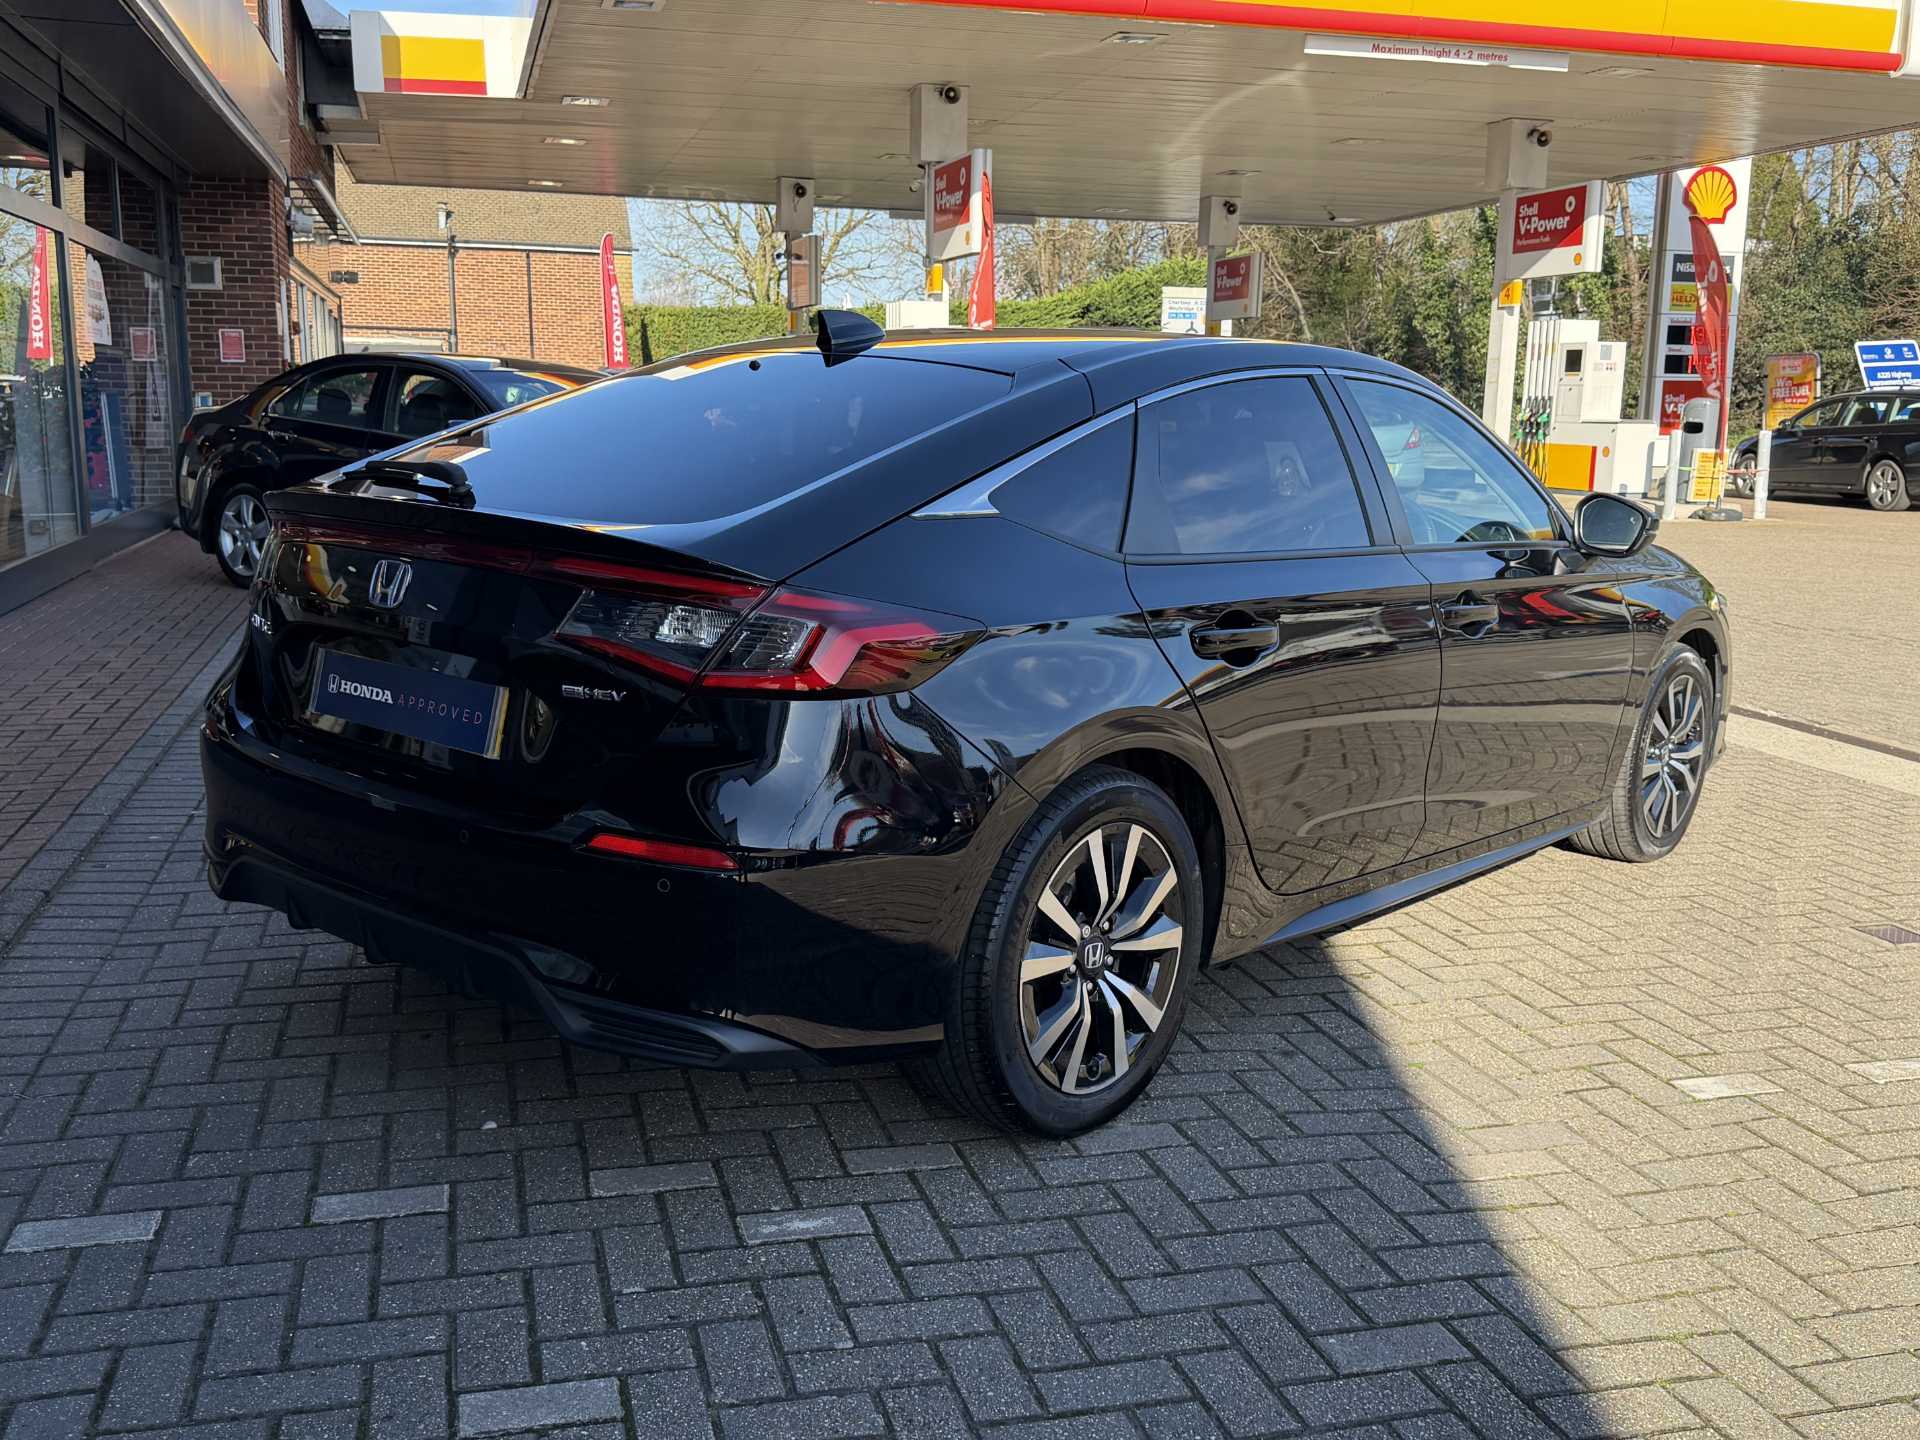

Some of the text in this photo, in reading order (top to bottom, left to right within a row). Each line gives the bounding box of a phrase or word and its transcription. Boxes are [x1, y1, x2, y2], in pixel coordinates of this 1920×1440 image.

[1371, 43, 1419, 55] Maximum
[1422, 46, 1451, 58] height
[1477, 52, 1508, 62] metres
[936, 190, 963, 210] V-Power
[1519, 202, 1538, 216] Shell
[1519, 215, 1570, 235] V-Power
[1216, 275, 1243, 289] V-Power
[611, 283, 624, 363] HONDA
[1775, 376, 1792, 387] Win
[1664, 394, 1685, 403] Shell
[1772, 384, 1809, 398] FREE FUEL
[340, 680, 393, 704] HONDA
[398, 694, 483, 725] APPROVED
